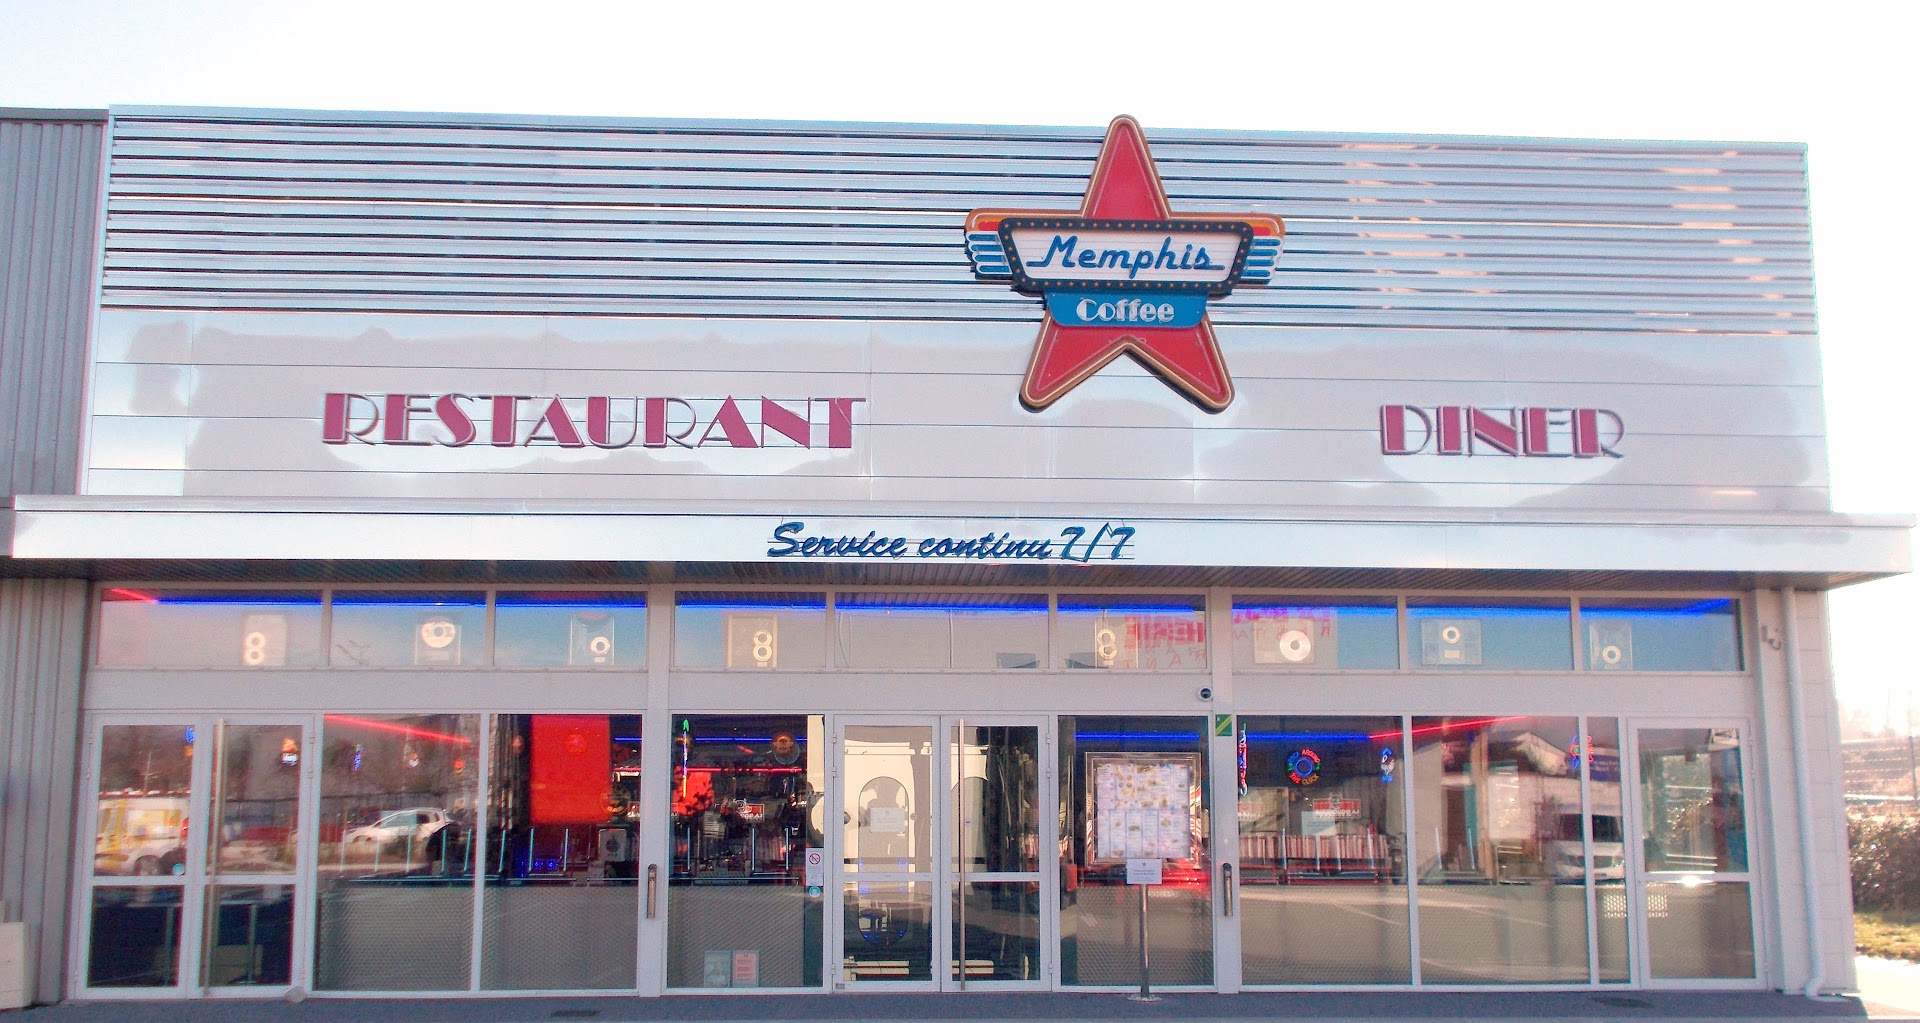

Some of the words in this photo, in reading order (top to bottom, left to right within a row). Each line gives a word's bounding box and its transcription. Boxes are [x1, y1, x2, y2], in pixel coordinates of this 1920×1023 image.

[1026, 235, 1226, 279] Memphis
[1076, 297, 1175, 324] Coffee
[322, 392, 867, 449] RESTAURANT
[1380, 404, 1626, 458] DINER
[767, 521, 908, 559] Service
[916, 531, 1053, 560] continu
[1060, 522, 1136, 563] 7/7
